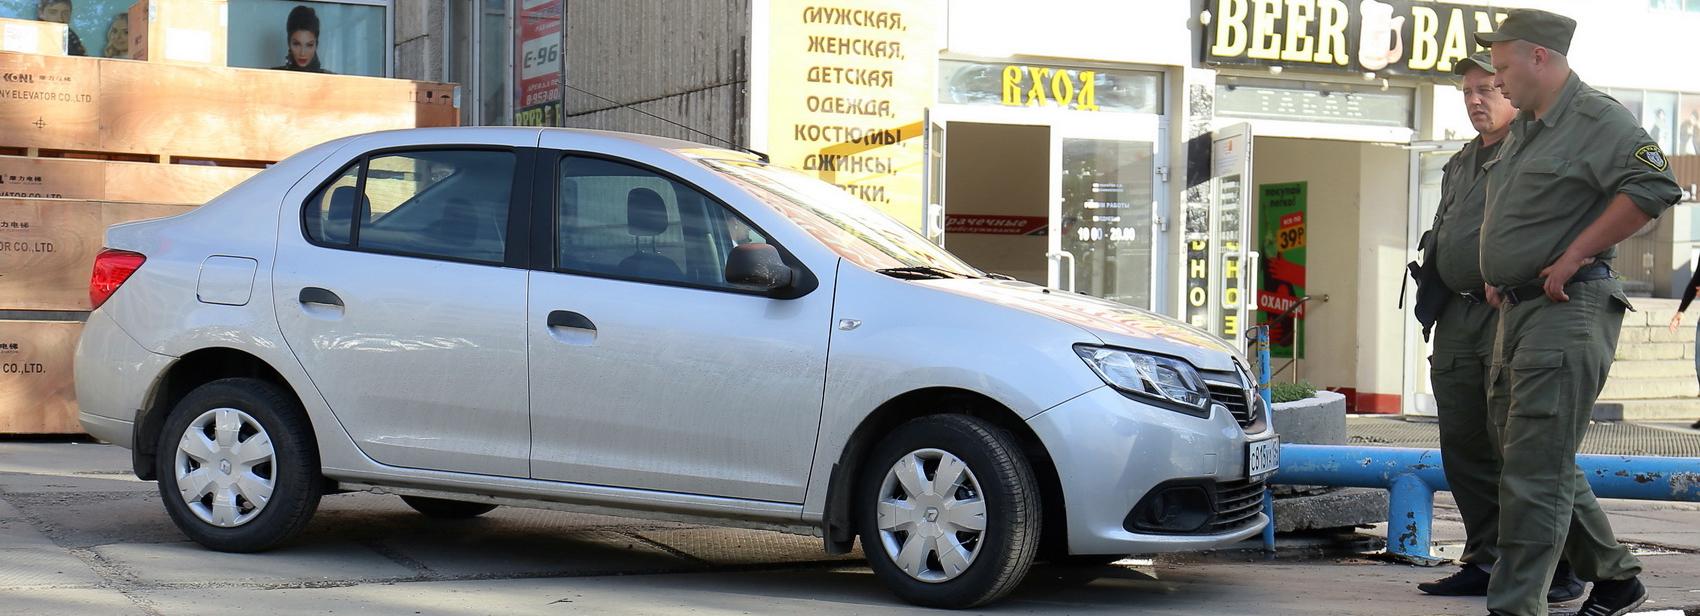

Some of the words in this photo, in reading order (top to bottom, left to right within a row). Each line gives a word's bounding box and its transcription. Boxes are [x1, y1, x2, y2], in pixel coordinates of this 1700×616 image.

[803, 7, 906, 31] МУЖСКАЯ,
[1212, 0, 1349, 65] BEER
[807, 36, 905, 60] ЖЕНСКАЯ,
[807, 66, 893, 88] ДЕТСКАЯ
[1002, 65, 1100, 111] ВХОД
[12, 90, 57, 101] ELEVATOR
[806, 95, 895, 119] ОДЕЖДА,
[795, 124, 906, 147] КОСТЮМЫ,
[803, 154, 898, 176] ДЖИНСЫ,
[833, 184, 890, 204] ТКИ,
